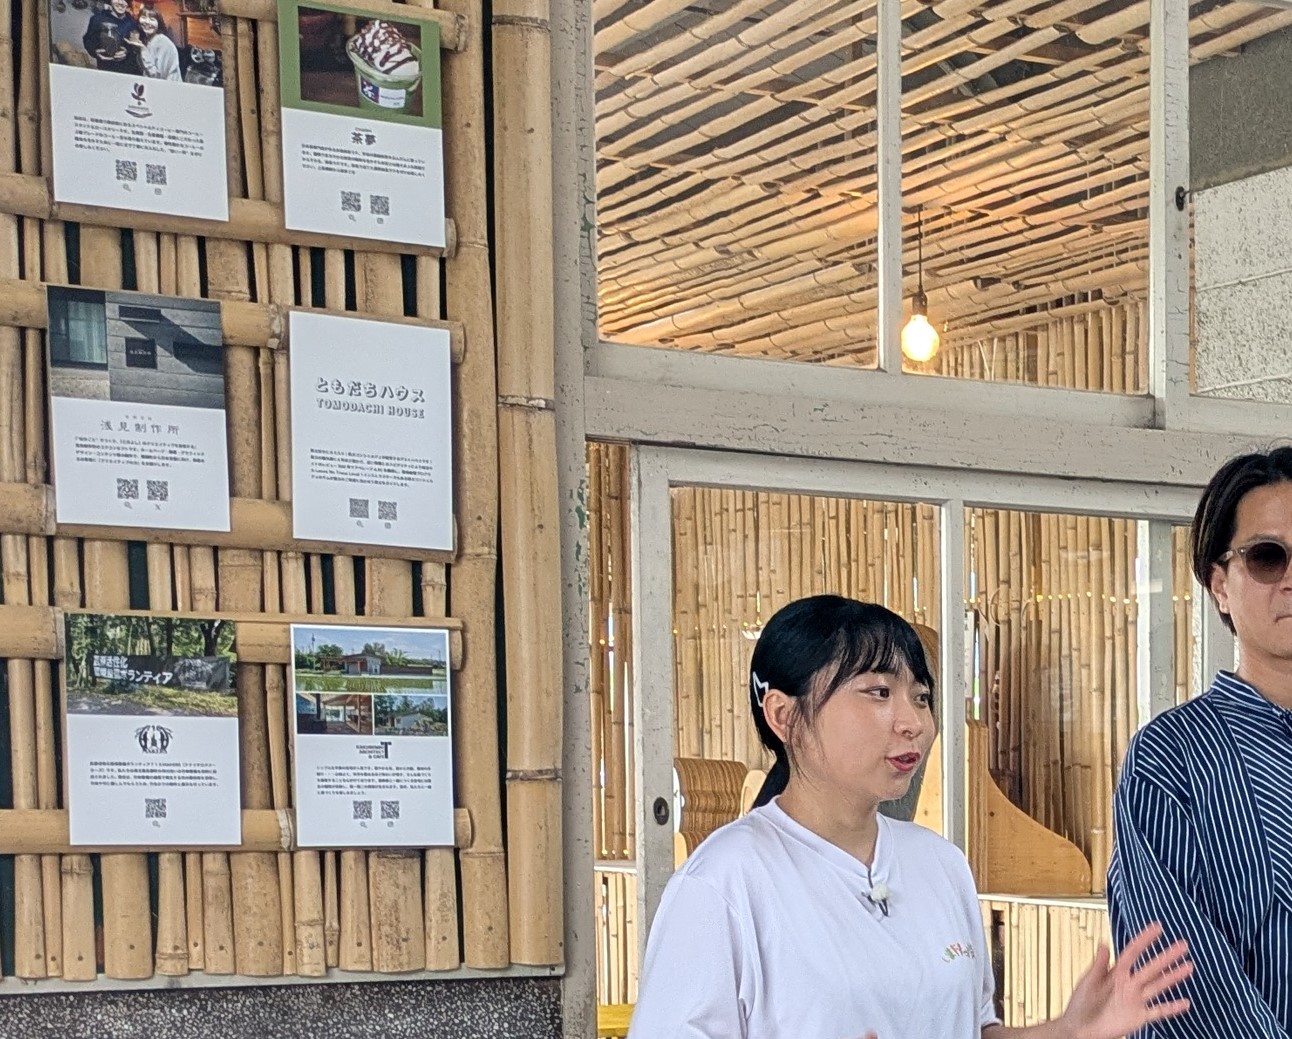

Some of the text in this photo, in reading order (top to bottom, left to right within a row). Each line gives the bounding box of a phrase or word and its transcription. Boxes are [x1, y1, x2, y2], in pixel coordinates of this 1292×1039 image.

[316, 377, 426, 403] ともだちハウス
[316, 398, 425, 419] TOMODACHI HOUSE
